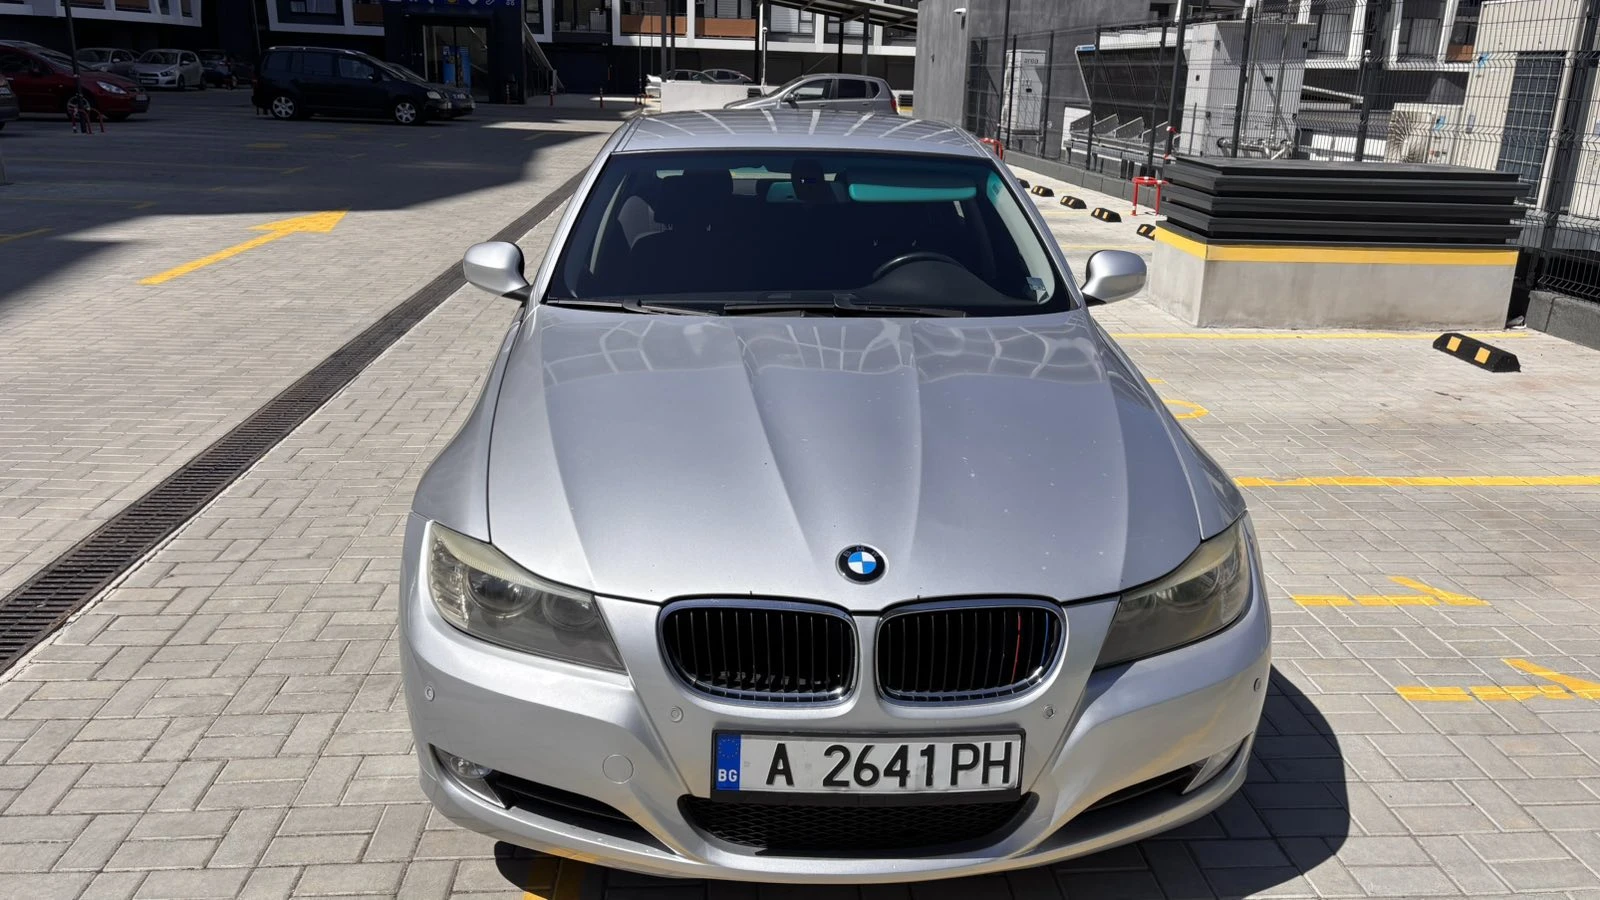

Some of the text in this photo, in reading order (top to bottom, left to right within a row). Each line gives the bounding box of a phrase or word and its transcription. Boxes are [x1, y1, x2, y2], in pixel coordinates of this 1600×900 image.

[718, 768, 738, 782] BG
[765, 741, 1012, 788] A 2641 PH
